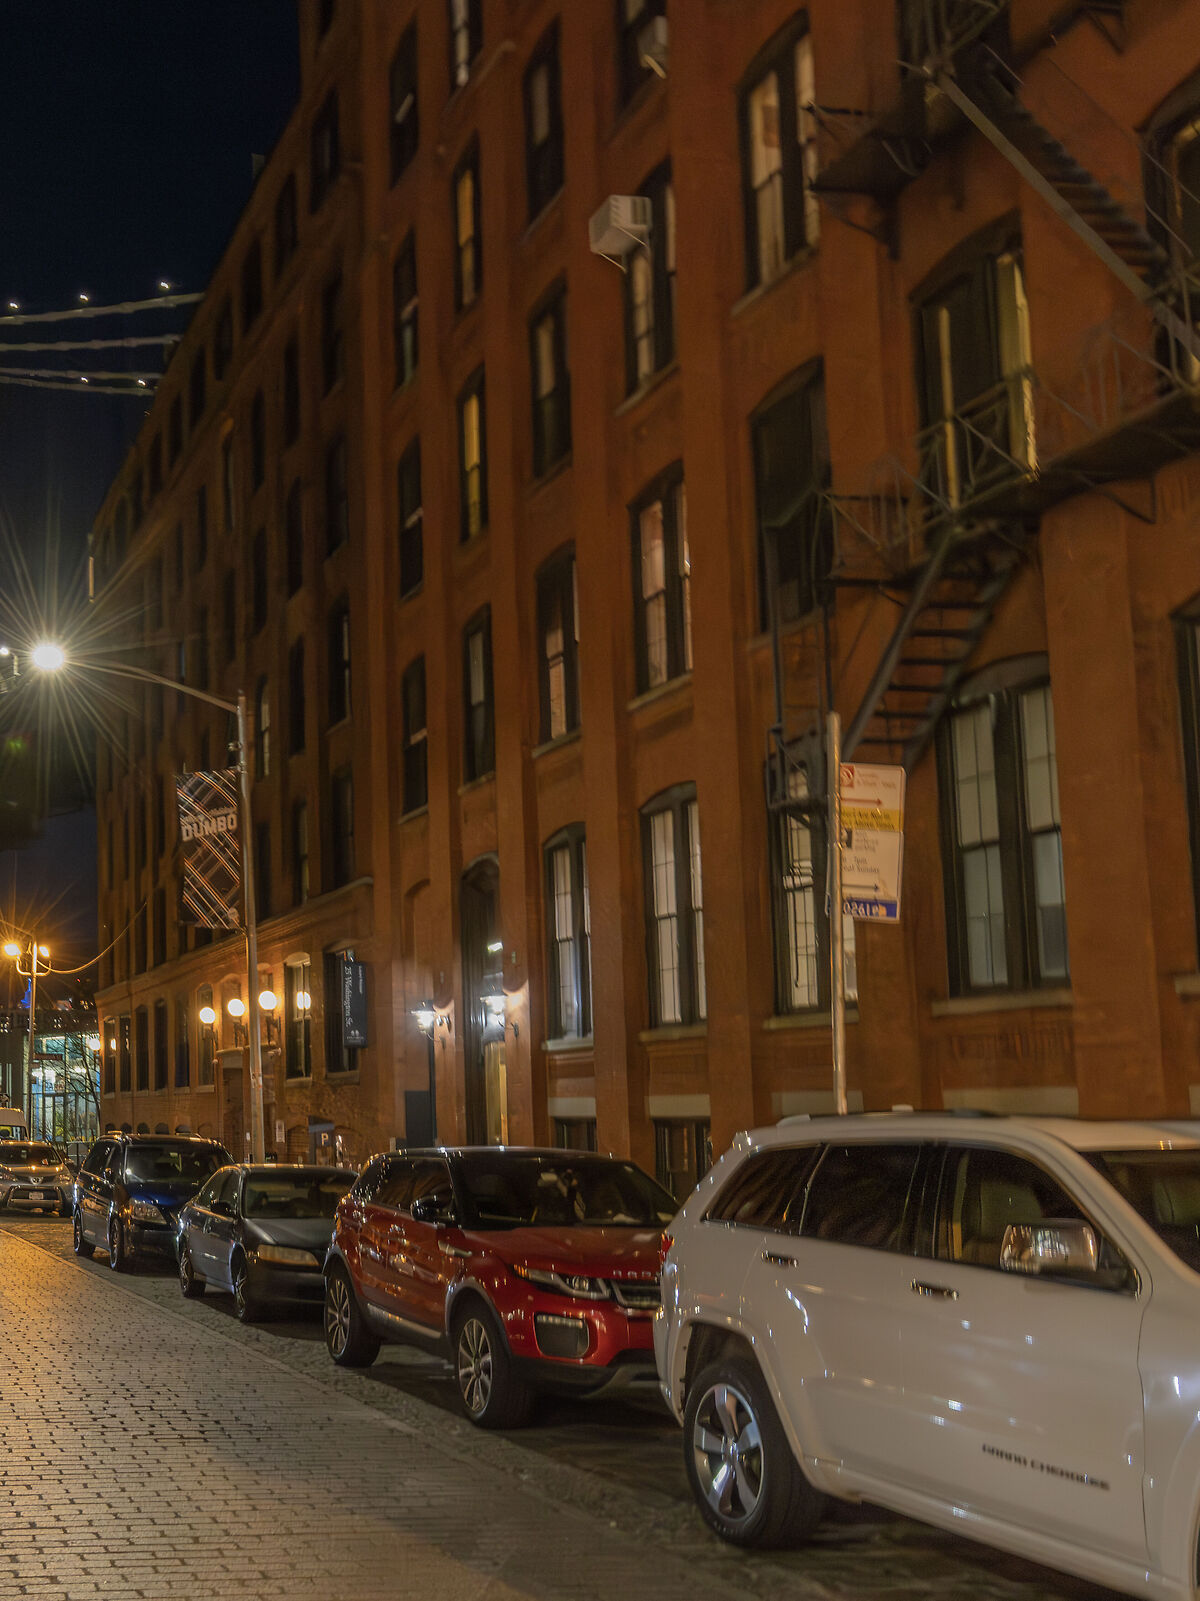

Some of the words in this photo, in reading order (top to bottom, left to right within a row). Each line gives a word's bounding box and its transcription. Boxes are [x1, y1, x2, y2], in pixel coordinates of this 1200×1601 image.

[181, 813, 238, 842] DUMBO
[344, 966, 352, 975] 25
[343, 977, 353, 1016] Washington
[321, 1132, 329, 1146] P
